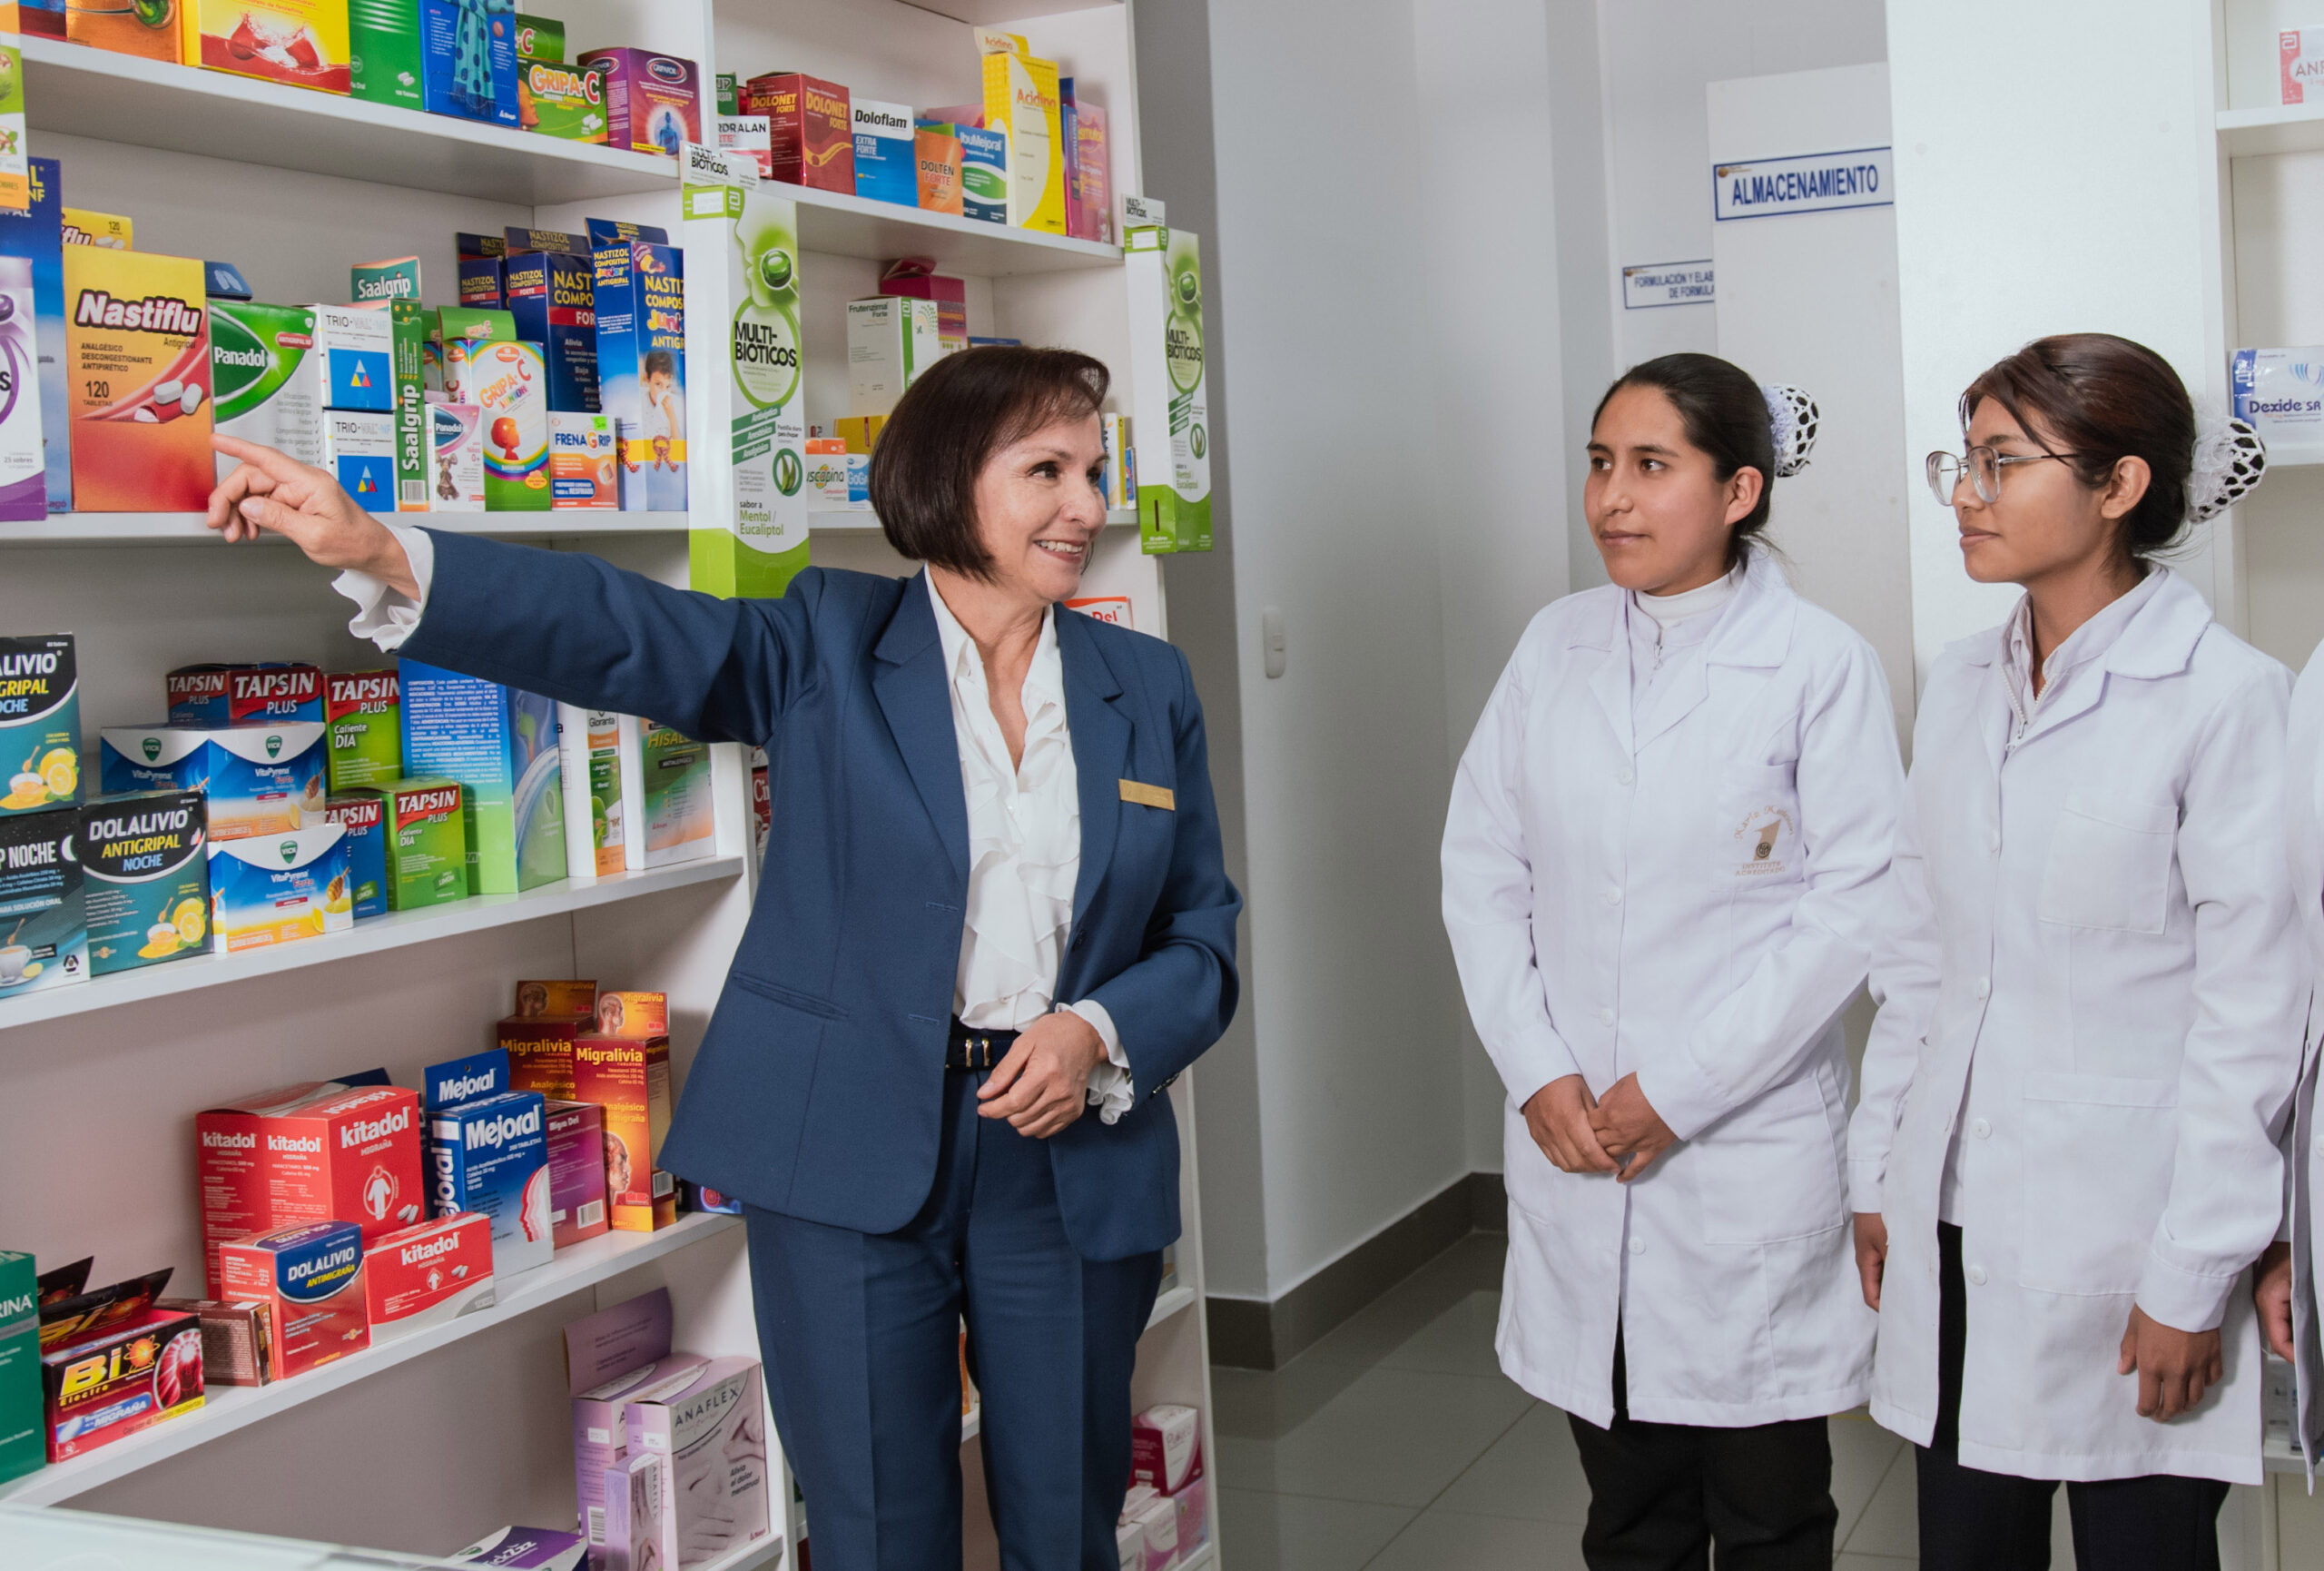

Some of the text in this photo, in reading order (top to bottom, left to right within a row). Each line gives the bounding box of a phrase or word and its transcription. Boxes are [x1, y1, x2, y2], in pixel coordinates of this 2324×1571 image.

[751, 94, 798, 108] DOLONET
[777, 104, 795, 114] FORTE
[806, 92, 847, 116] DOLONET
[830, 117, 847, 131] FORTE
[854, 110, 907, 129] Doloflam
[856, 136, 876, 146] EXTRA
[857, 145, 877, 155] FORTE
[921, 160, 953, 175] DOLTEN
[1732, 164, 1878, 206] ALMACENAMIENTO
[594, 248, 629, 260] NASTIZOL
[462, 276, 495, 287] NASTIZOL
[510, 270, 544, 281] NASTIZOL
[510, 278, 544, 287] COMPOSITUM
[554, 271, 593, 291] NAST
[359, 272, 410, 301] Saalgrip
[519, 287, 535, 295] FORTE
[645, 276, 684, 295] NASTI
[1669, 285, 1714, 298] DE FORMULA
[555, 290, 594, 306] COMPO
[645, 294, 684, 310] COMPOS
[77, 291, 201, 334] Nastiflu
[576, 311, 595, 325] FOR
[734, 321, 777, 344] MULTI-
[214, 346, 265, 367] Panadol
[735, 342, 797, 368] BIOTICOS
[84, 380, 109, 398] 120
[2250, 399, 2320, 413] Dexide SR
[398, 384, 421, 471] Saalgrip
[739, 500, 755, 509] sabor
[740, 509, 771, 522] Mentol
[740, 523, 783, 538] Eucaliptol
[169, 675, 224, 693] TAPSIN
[235, 672, 315, 698] TAPSIN
[331, 677, 399, 701] TAPSIN
[189, 696, 209, 705] PLUS
[267, 700, 297, 715] PLUS
[359, 701, 388, 715] PLUS
[334, 724, 367, 735] Caliente
[145, 744, 161, 752] VICK
[335, 735, 356, 748] DIA
[398, 790, 456, 814] TAPSIN
[89, 809, 188, 841] DOLALIVIO
[428, 814, 448, 824] PLUS
[348, 826, 368, 837] PLUS
[399, 828, 423, 837] Caliente
[102, 834, 182, 858] ANTIGRIPAL
[400, 837, 414, 846] DIA
[8, 841, 56, 868] NOCHE
[281, 846, 297, 855] VICK
[123, 855, 162, 872] NOCHE
[501, 1039, 572, 1056] Migralivia
[576, 1047, 644, 1065] Migralivia
[438, 1069, 495, 1102] Mejoral
[340, 1106, 409, 1149] kitadol
[466, 1110, 540, 1151] Mejoral
[202, 1131, 255, 1148] kitadol
[268, 1136, 321, 1152] kitadol
[361, 1140, 392, 1156] MIGRAÑA
[401, 1232, 458, 1266] kitadol
[288, 1247, 355, 1281] DOLALIVIO
[306, 1264, 355, 1289] ANTIMIGRAÑA
[675, 1388, 738, 1428] ANAFLEX
